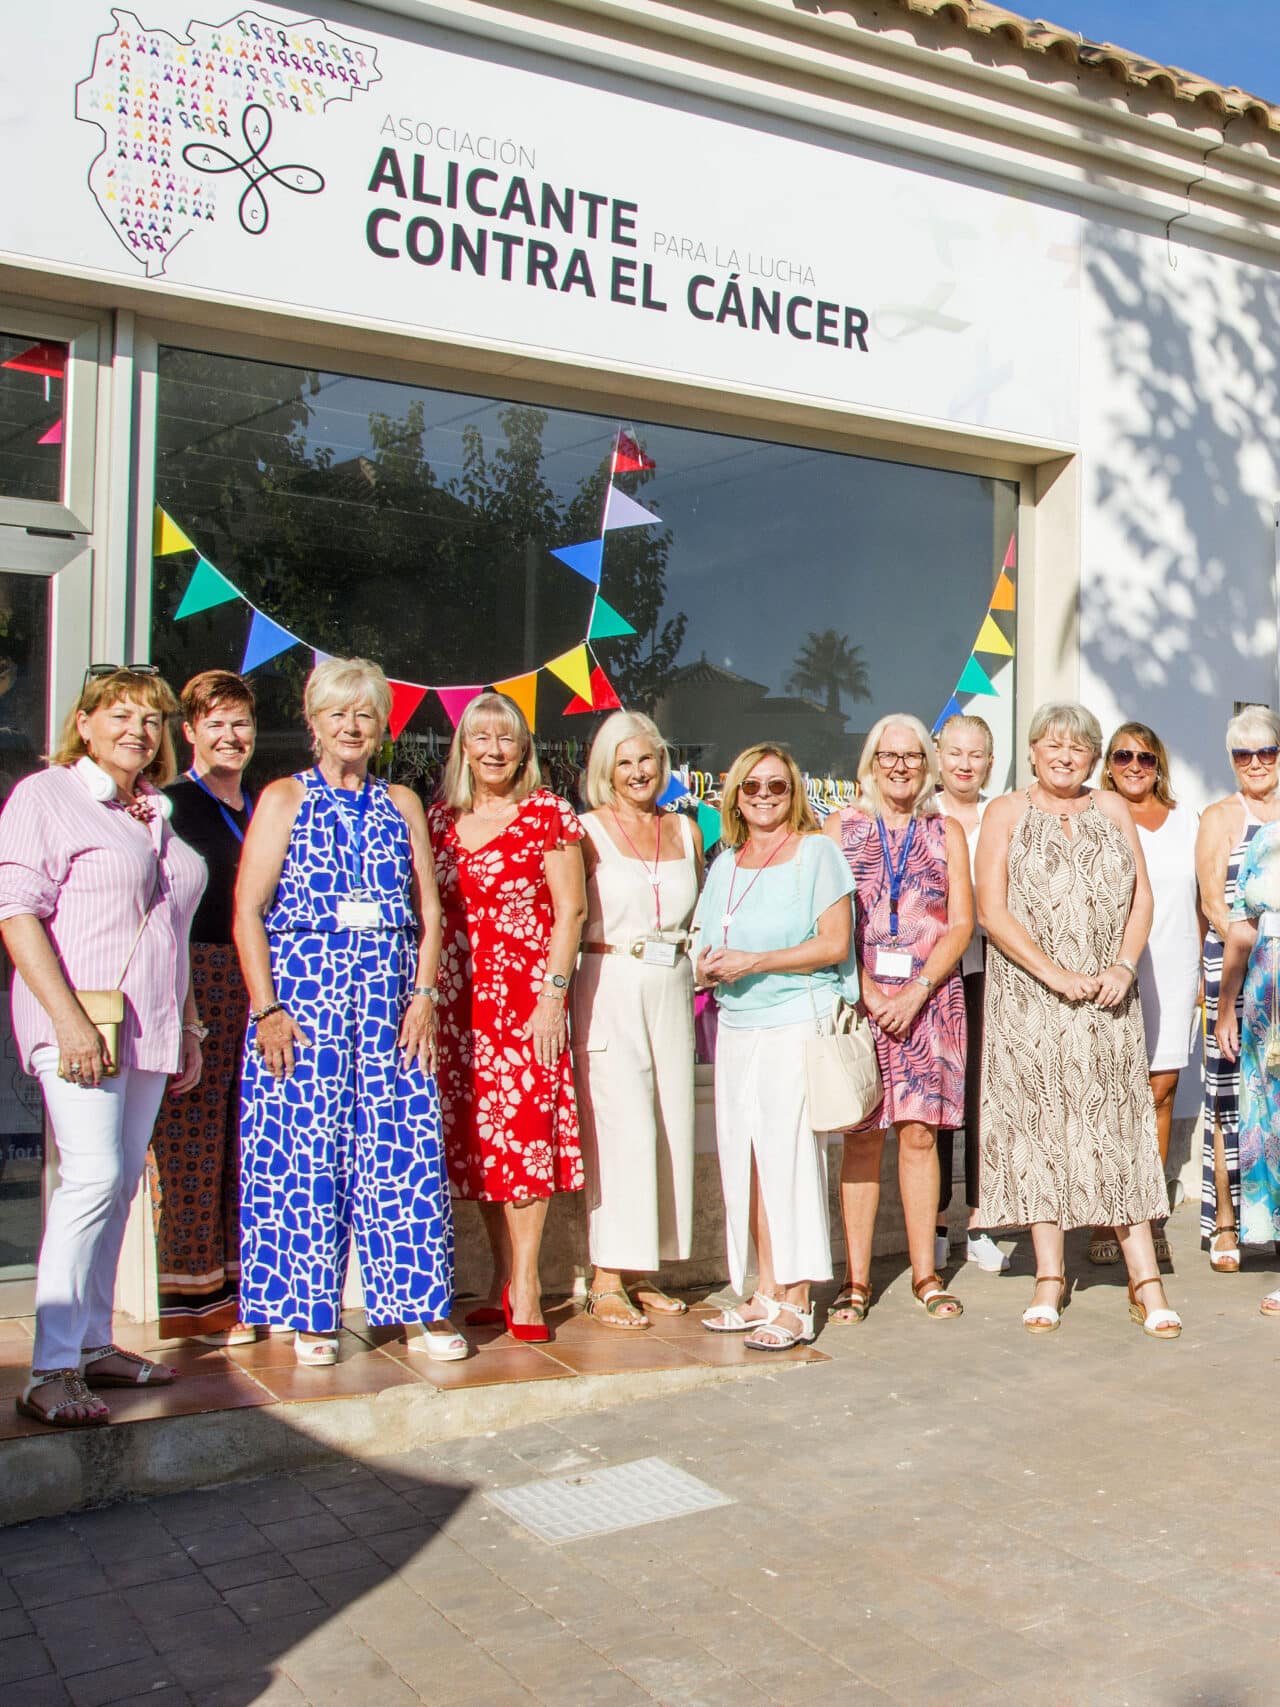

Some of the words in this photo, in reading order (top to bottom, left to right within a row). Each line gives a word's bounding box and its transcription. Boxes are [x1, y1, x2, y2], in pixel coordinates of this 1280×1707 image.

[379, 113, 536, 170] ASOCIACIÓN
[367, 146, 638, 248] ALICANTE
[365, 207, 597, 298] CONTRA
[610, 255, 668, 313] EL
[686, 272, 869, 353] CÁNCER
[653, 231, 708, 264] PARA
[715, 245, 741, 271] LA
[748, 252, 816, 287] LUCHA
